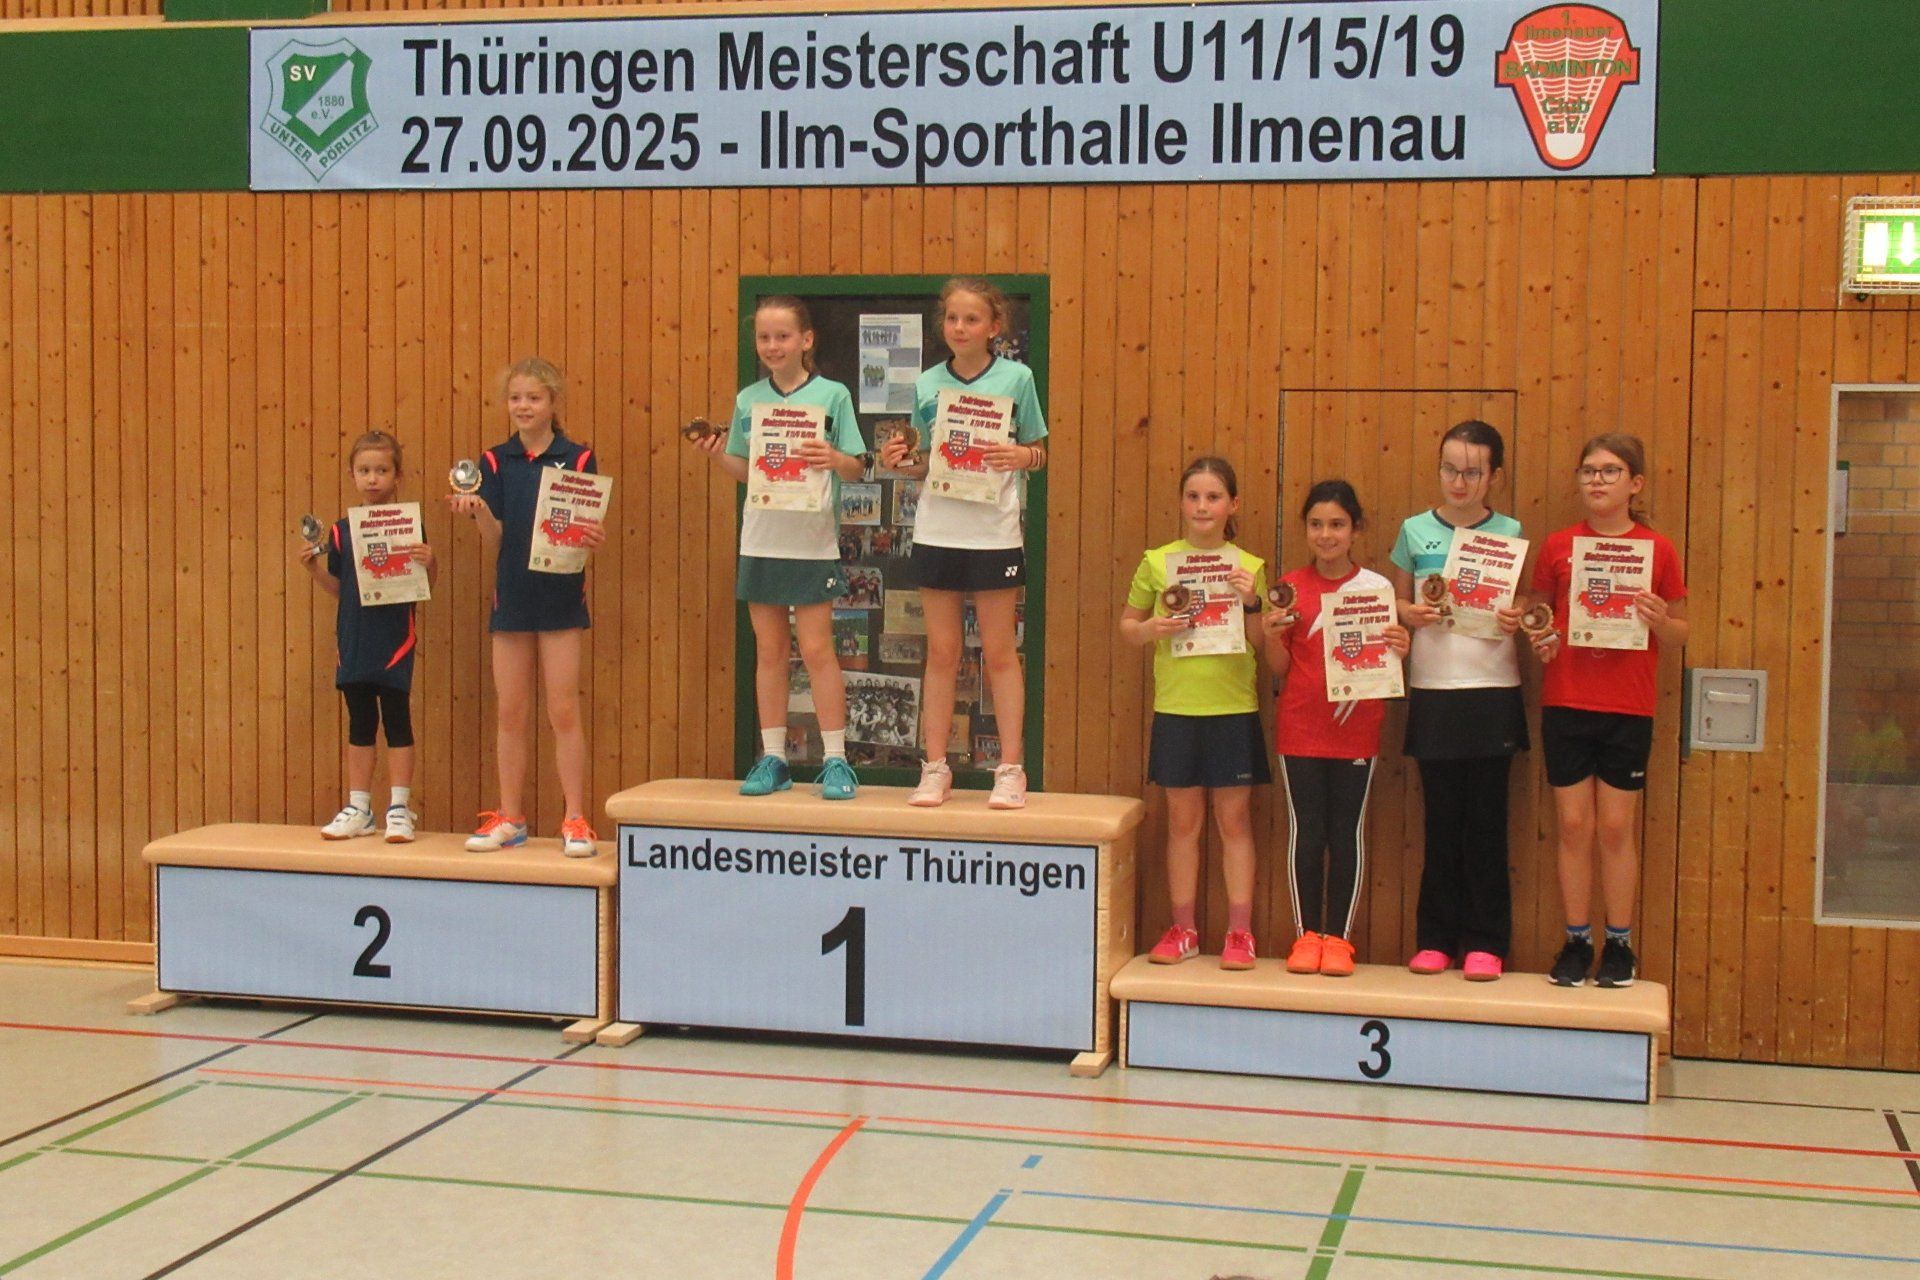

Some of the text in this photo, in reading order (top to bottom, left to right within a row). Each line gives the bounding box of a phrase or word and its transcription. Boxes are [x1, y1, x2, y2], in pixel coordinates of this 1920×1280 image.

[289, 65, 317, 81] SV
[403, 13, 1466, 110] Thüringen Meisterschaft U11/15/19
[1504, 58, 1632, 79] BADMINTON
[318, 95, 345, 107] 1880
[270, 118, 372, 169] UNTER PÖRLITZ
[400, 112, 701, 174] 27.09.2025
[760, 104, 1188, 183] Ilm-Sporthalle
[1212, 102, 1467, 164] Ilmenau
[627, 834, 1086, 897] Landesmeister Thüringen
[352, 905, 392, 979] 2
[821, 906, 866, 1027] 1
[1358, 1019, 1393, 1079] 3
